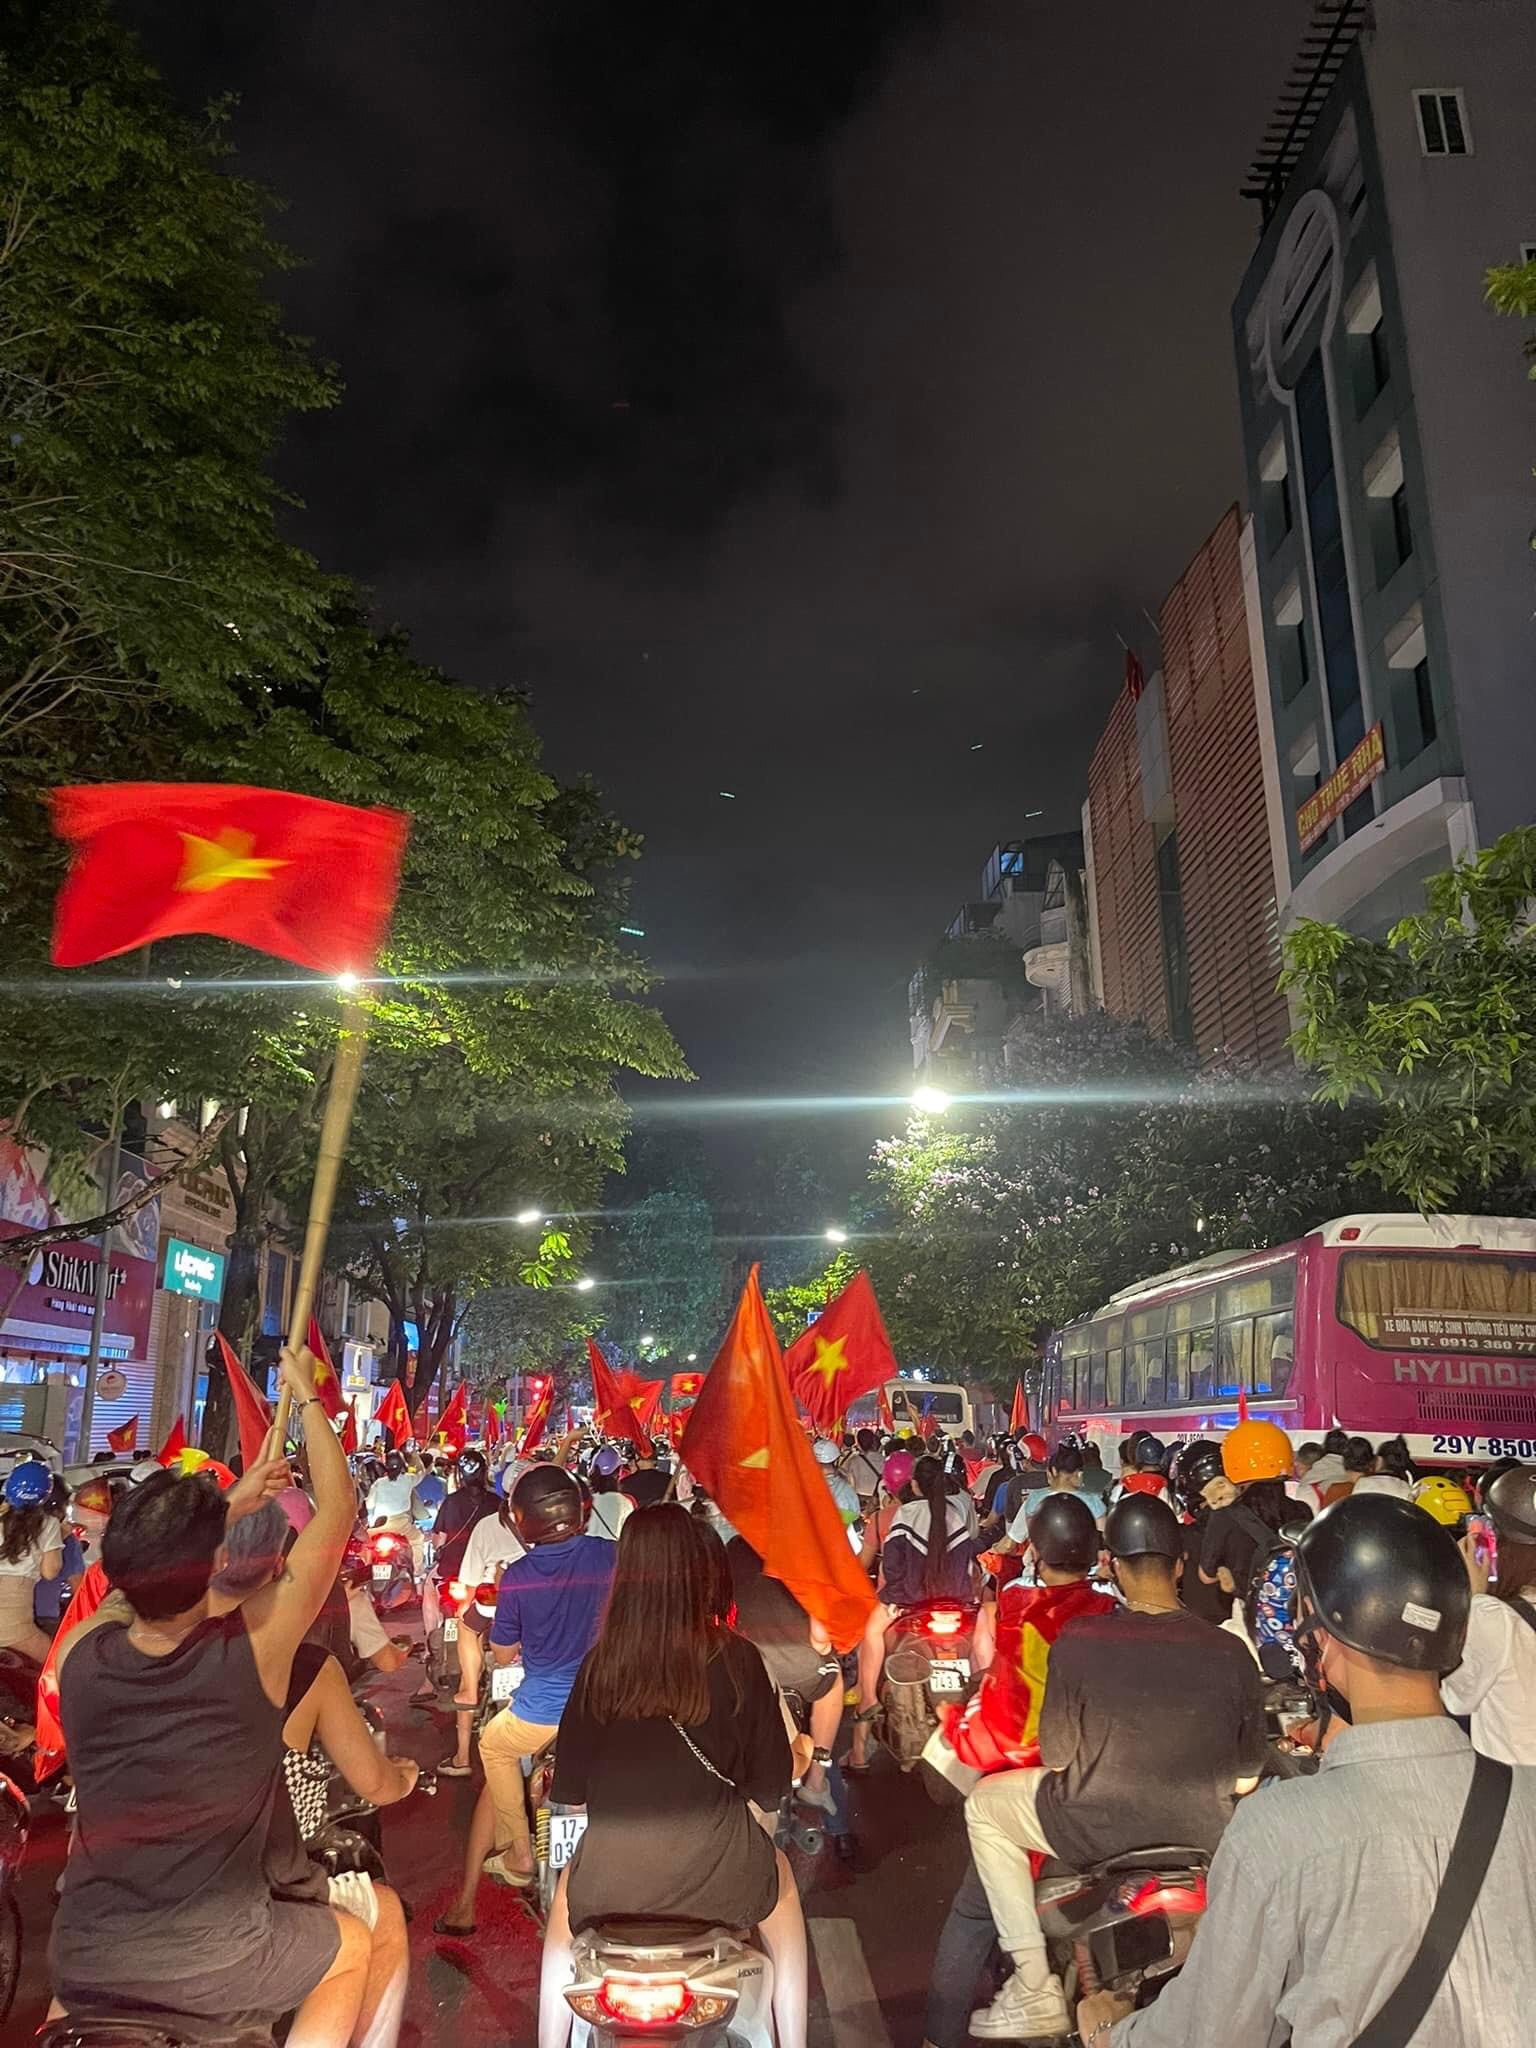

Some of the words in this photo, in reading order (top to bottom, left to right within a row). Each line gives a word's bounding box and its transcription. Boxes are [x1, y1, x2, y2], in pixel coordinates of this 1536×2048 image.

[1320, 763, 1350, 811] THUÊ
[1351, 728, 1383, 779] NHÀ
[46, 1250, 119, 1300] ShikiMrt
[1384, 1319, 1395, 1331] XE
[1428, 1320, 1444, 1336] HỌC
[1445, 1321, 1463, 1334] SINH
[1464, 1320, 1492, 1336] TRƯỜNG
[1493, 1320, 1508, 1336] TIỂU
[1510, 1324, 1524, 1338] HỌC
[1440, 1337, 1478, 1348] 0913
[1433, 1435, 1536, 1457] 29Y-850
